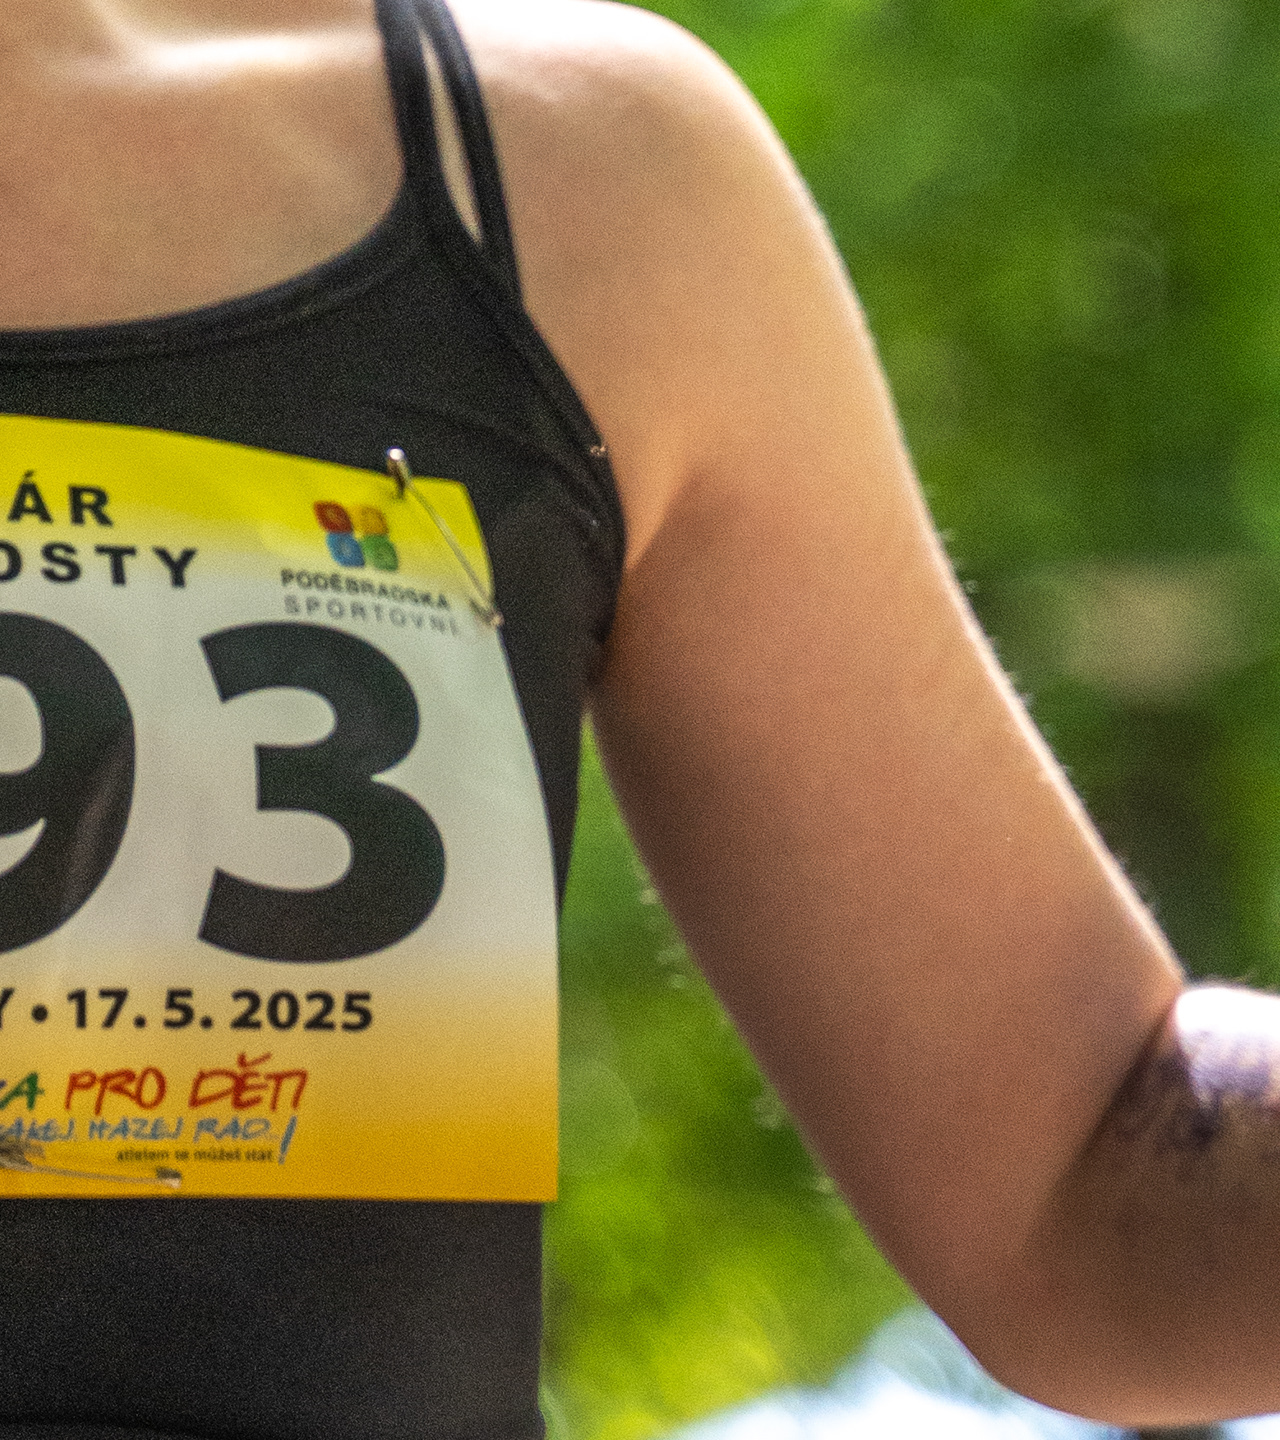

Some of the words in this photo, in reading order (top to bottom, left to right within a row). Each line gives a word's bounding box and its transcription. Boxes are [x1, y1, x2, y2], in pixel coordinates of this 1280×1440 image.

[230, 989, 374, 1033] 2025
[64, 1067, 167, 1116] PRO
[189, 1051, 308, 1112] DĚTI
